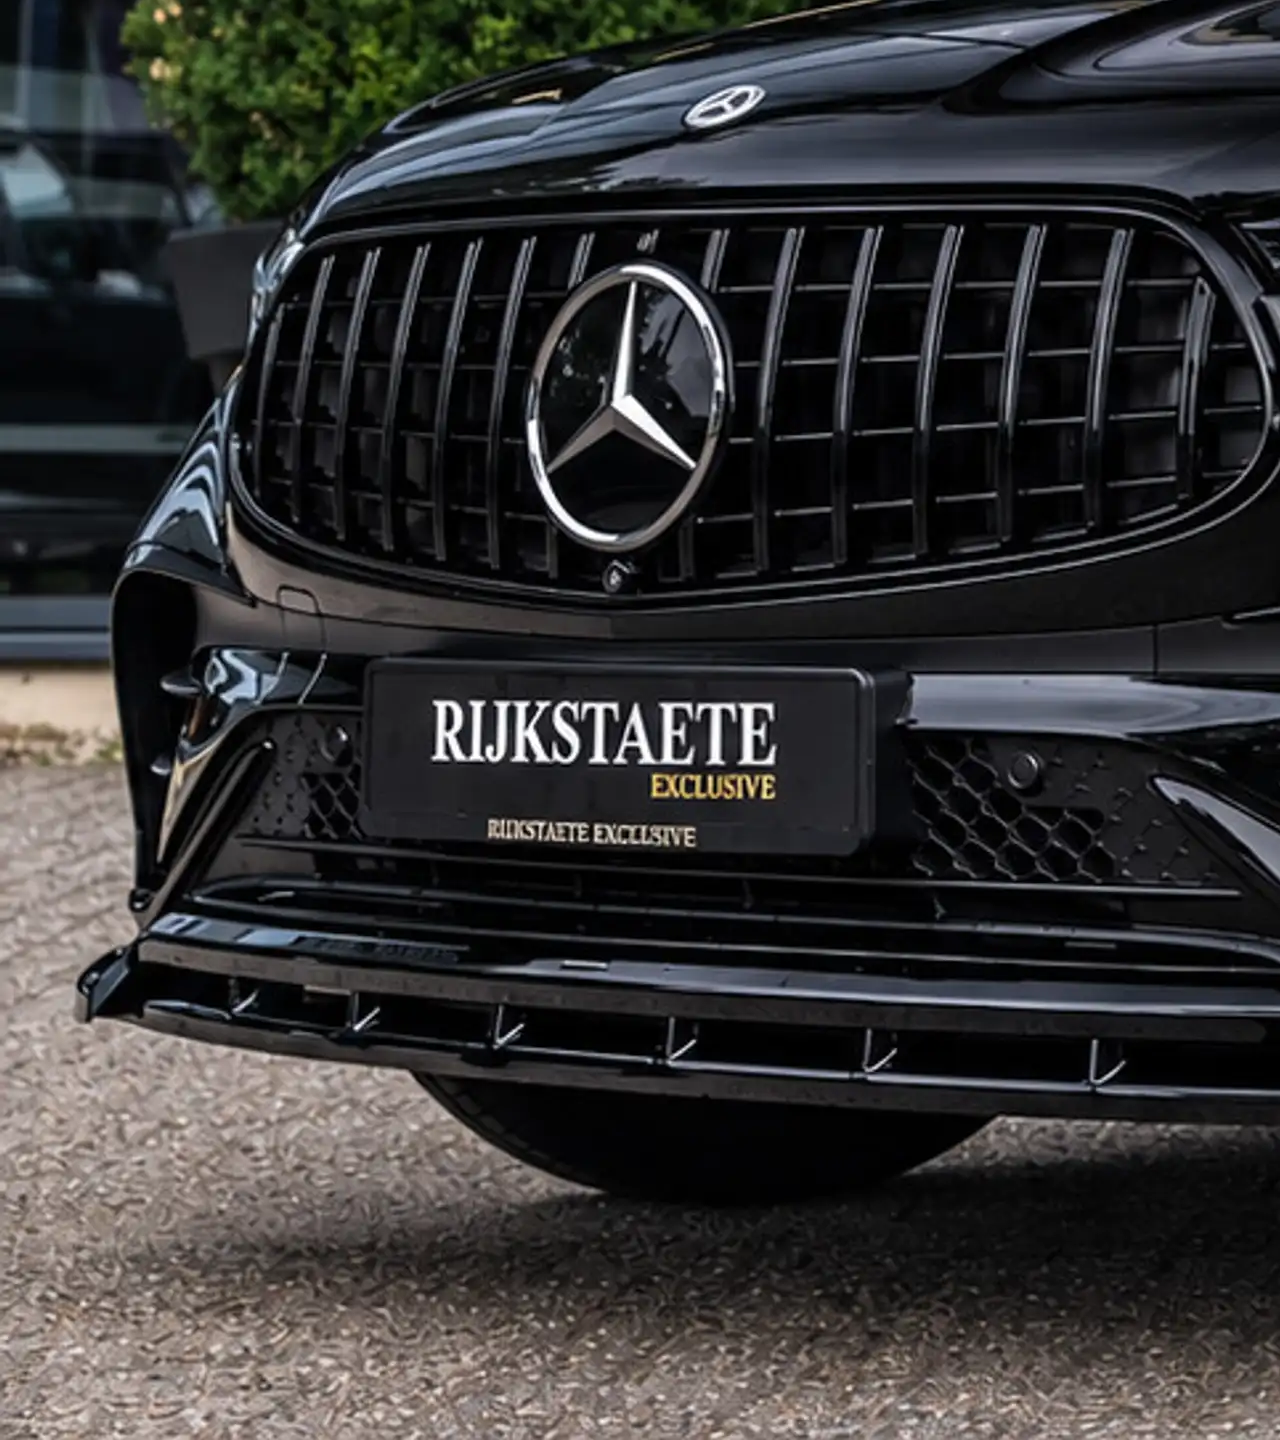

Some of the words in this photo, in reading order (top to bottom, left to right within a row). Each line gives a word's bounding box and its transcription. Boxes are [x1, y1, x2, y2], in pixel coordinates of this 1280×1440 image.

[430, 698, 778, 766] RIJKSTAETE
[649, 772, 777, 800] EXCLUSIVE
[486, 817, 591, 843] RIJKSTAETE
[592, 821, 698, 848] EXCLUSIVE
